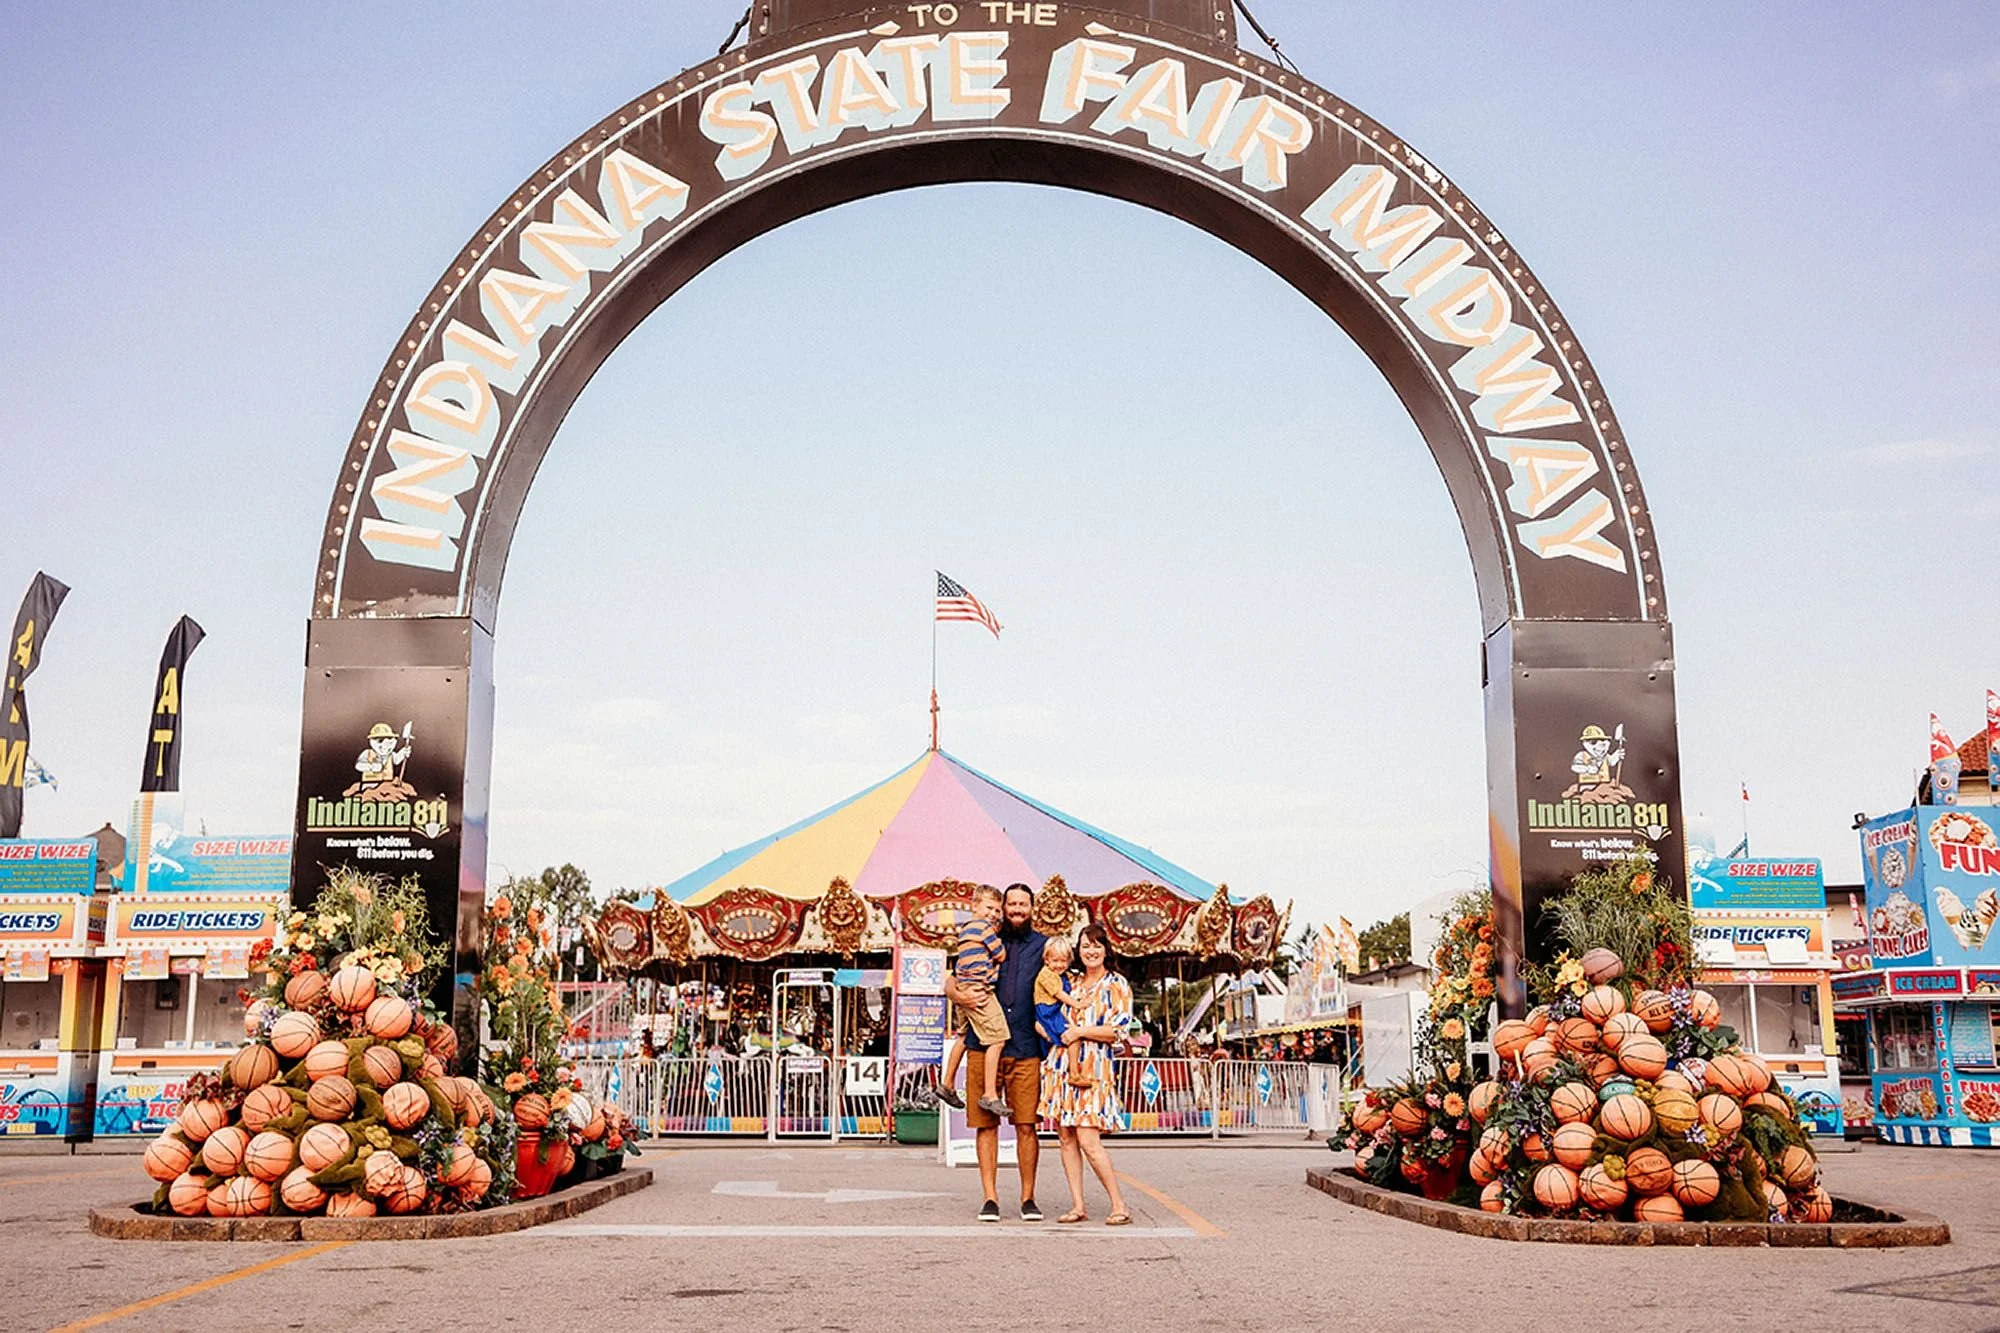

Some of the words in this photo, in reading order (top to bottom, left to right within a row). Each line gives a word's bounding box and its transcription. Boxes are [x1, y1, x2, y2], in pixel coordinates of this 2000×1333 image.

[908, 4, 957, 27] TO
[981, 2, 1058, 26] THE
[359, 148, 691, 572] INDIANA
[699, 31, 1012, 182] STATE
[1039, 37, 1314, 193] FAIR
[1300, 164, 1628, 574] MIDWAY
[306, 797, 412, 827] Indiana
[1527, 799, 1632, 828] Indiana
[1881, 823, 1911, 844] CREAM
[39, 843, 91, 859] WIZE
[193, 840, 238, 857] SIZE
[239, 839, 290, 856] WIZE
[400, 850, 417, 860] you
[1728, 863, 1767, 877] SIZE
[1771, 863, 1817, 877] WIZE
[132, 913, 179, 928] RIDE
[185, 912, 262, 927] TICKETS
[1738, 928, 1808, 941] TICKETS
[1902, 928, 1929, 955] CAKES
[1895, 977, 1914, 990] ICE
[1915, 976, 1957, 990] CREAM
[850, 1061, 881, 1082] 14
